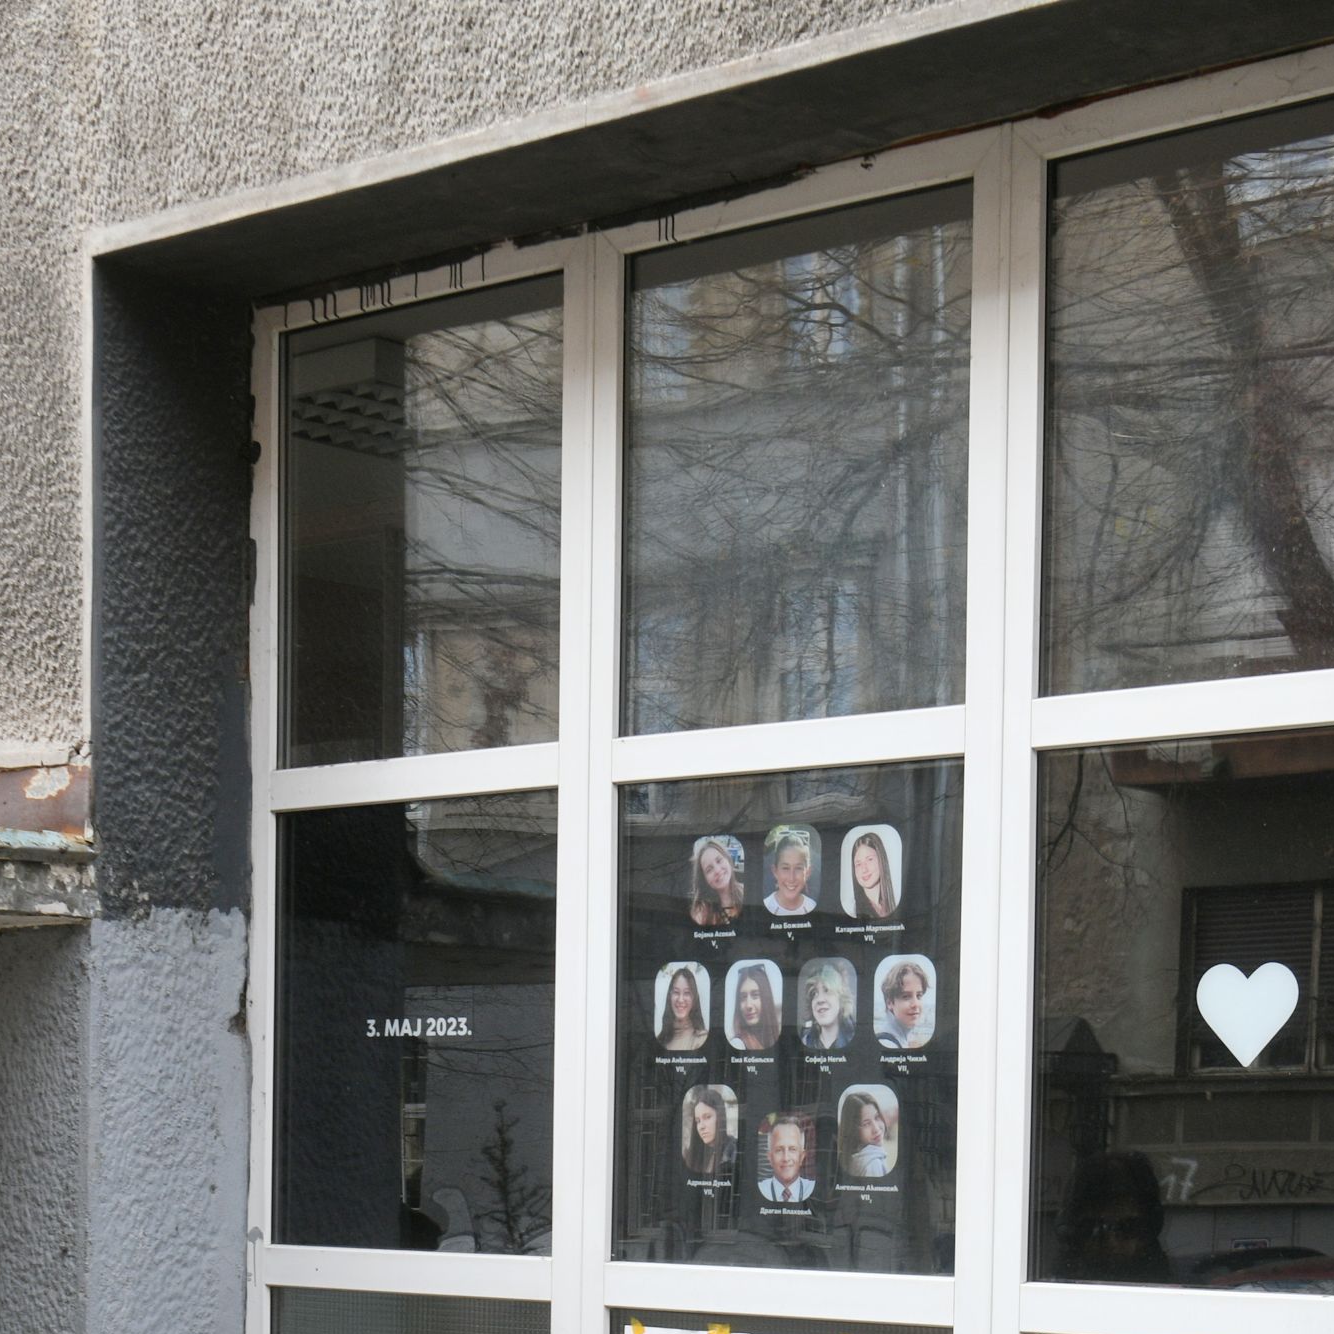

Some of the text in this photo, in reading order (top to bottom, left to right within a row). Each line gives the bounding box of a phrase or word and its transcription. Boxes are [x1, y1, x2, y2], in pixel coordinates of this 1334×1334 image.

[367, 1017, 472, 1038] 3. MAJ 2023.
